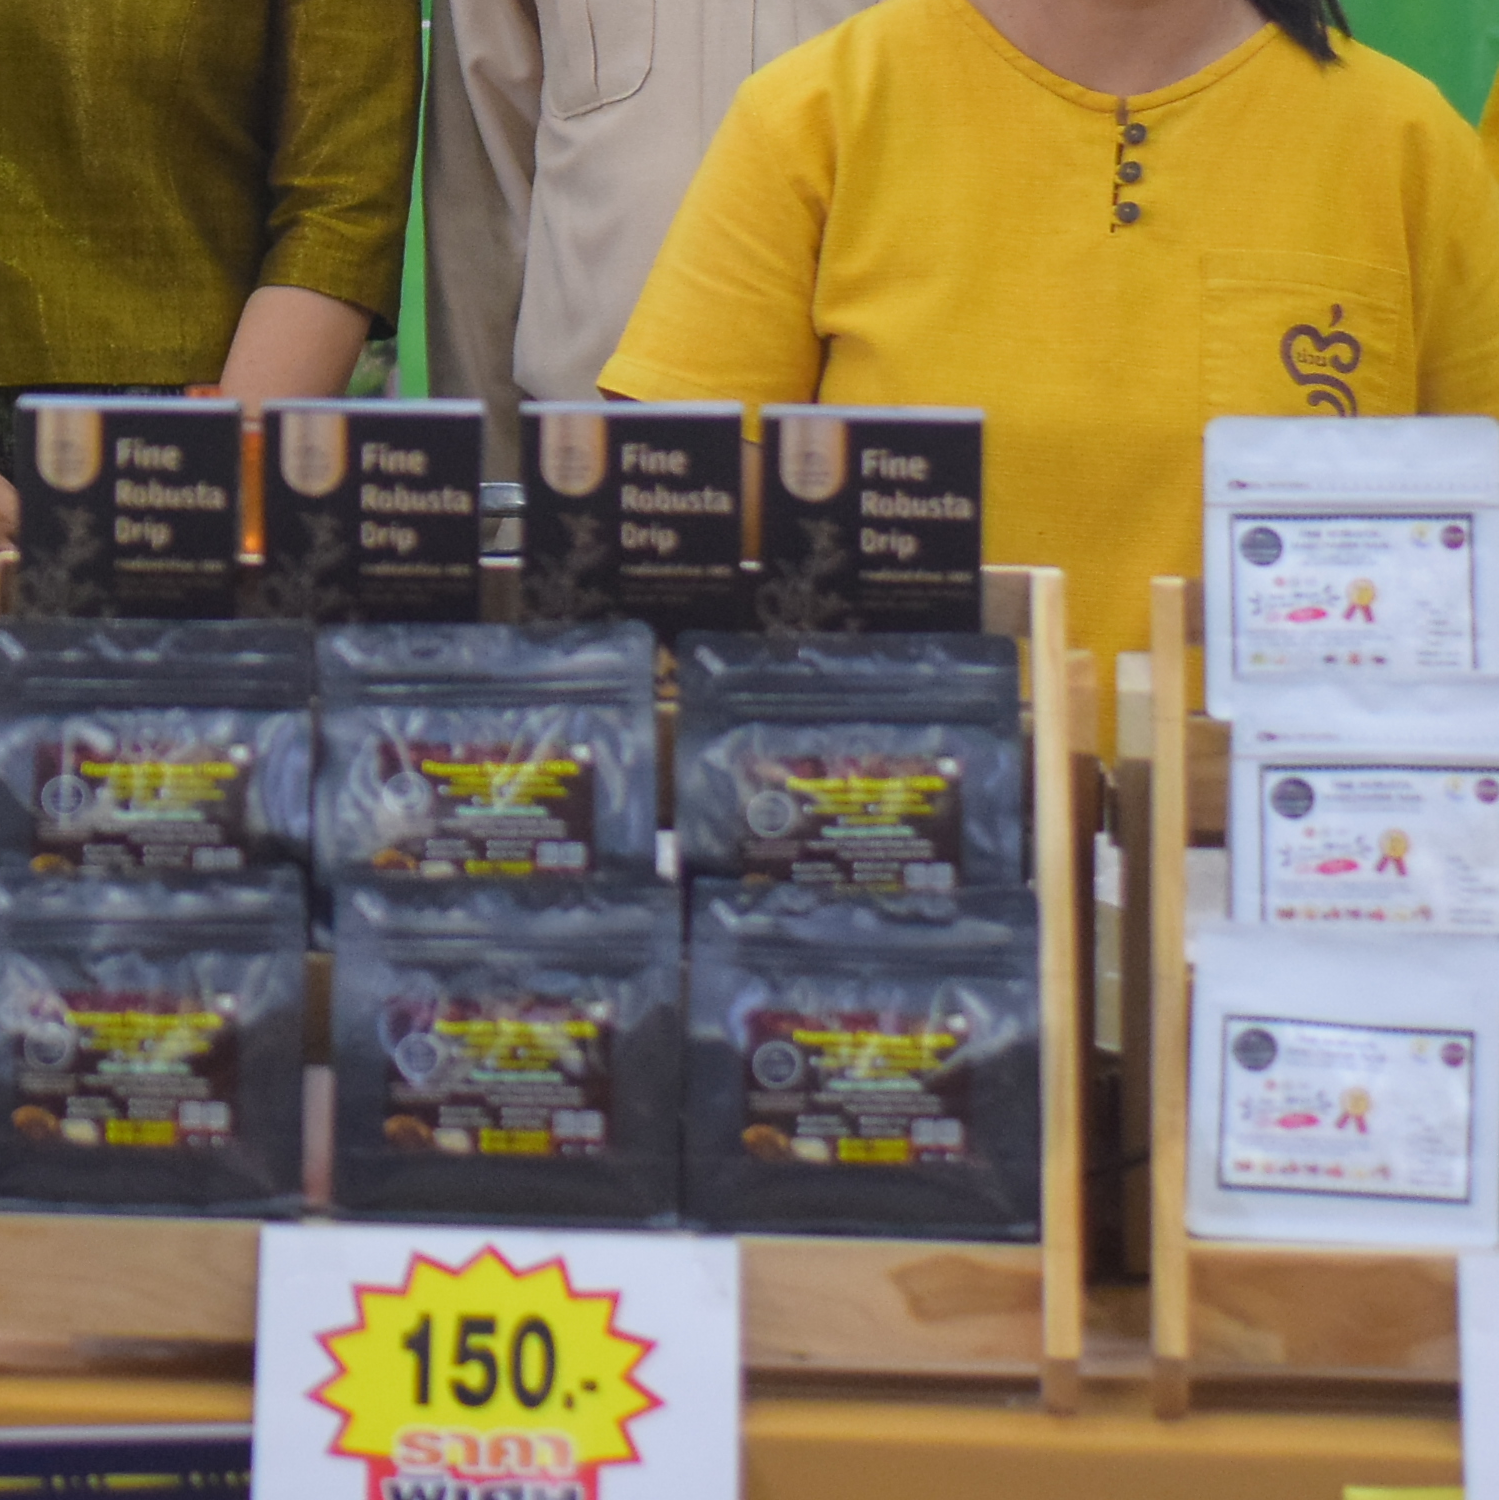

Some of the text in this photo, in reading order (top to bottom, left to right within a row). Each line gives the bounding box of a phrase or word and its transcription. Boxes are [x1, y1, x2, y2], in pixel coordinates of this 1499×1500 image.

[116, 437, 183, 472] Fine
[361, 442, 428, 477] Fine
[622, 441, 689, 476] Fine
[861, 447, 928, 482] Fine
[115, 478, 228, 510] Robusta
[360, 483, 473, 515] Robusta
[621, 482, 734, 514] Robusta
[860, 488, 973, 520] Robusta
[114, 515, 173, 549] Drip
[359, 520, 418, 554] Drip
[620, 519, 679, 553] Drip
[859, 525, 918, 559] Drip
[400, 1311, 600, 1410] 150.-
[396, 1431, 573, 1468] ราคา
